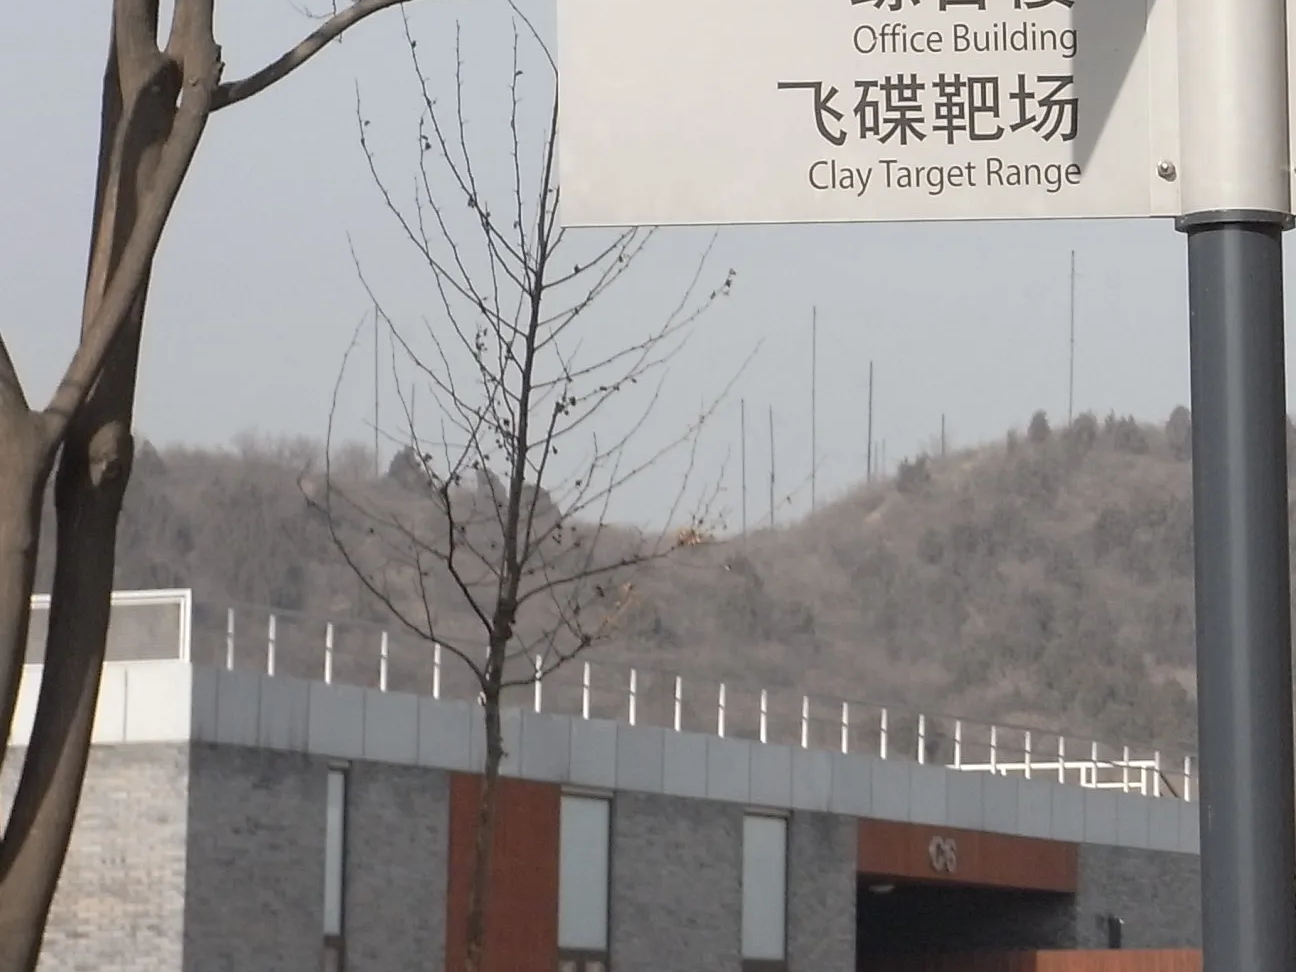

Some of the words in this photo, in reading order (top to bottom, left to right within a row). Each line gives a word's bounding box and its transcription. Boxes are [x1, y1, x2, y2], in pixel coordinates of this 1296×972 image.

[852, 23, 944, 54] Office
[952, 22, 1079, 57] Building
[776, 72, 1080, 146] 飞碟靶场
[808, 158, 873, 197] Clay
[879, 159, 977, 196] Target
[985, 157, 1082, 193] Range
